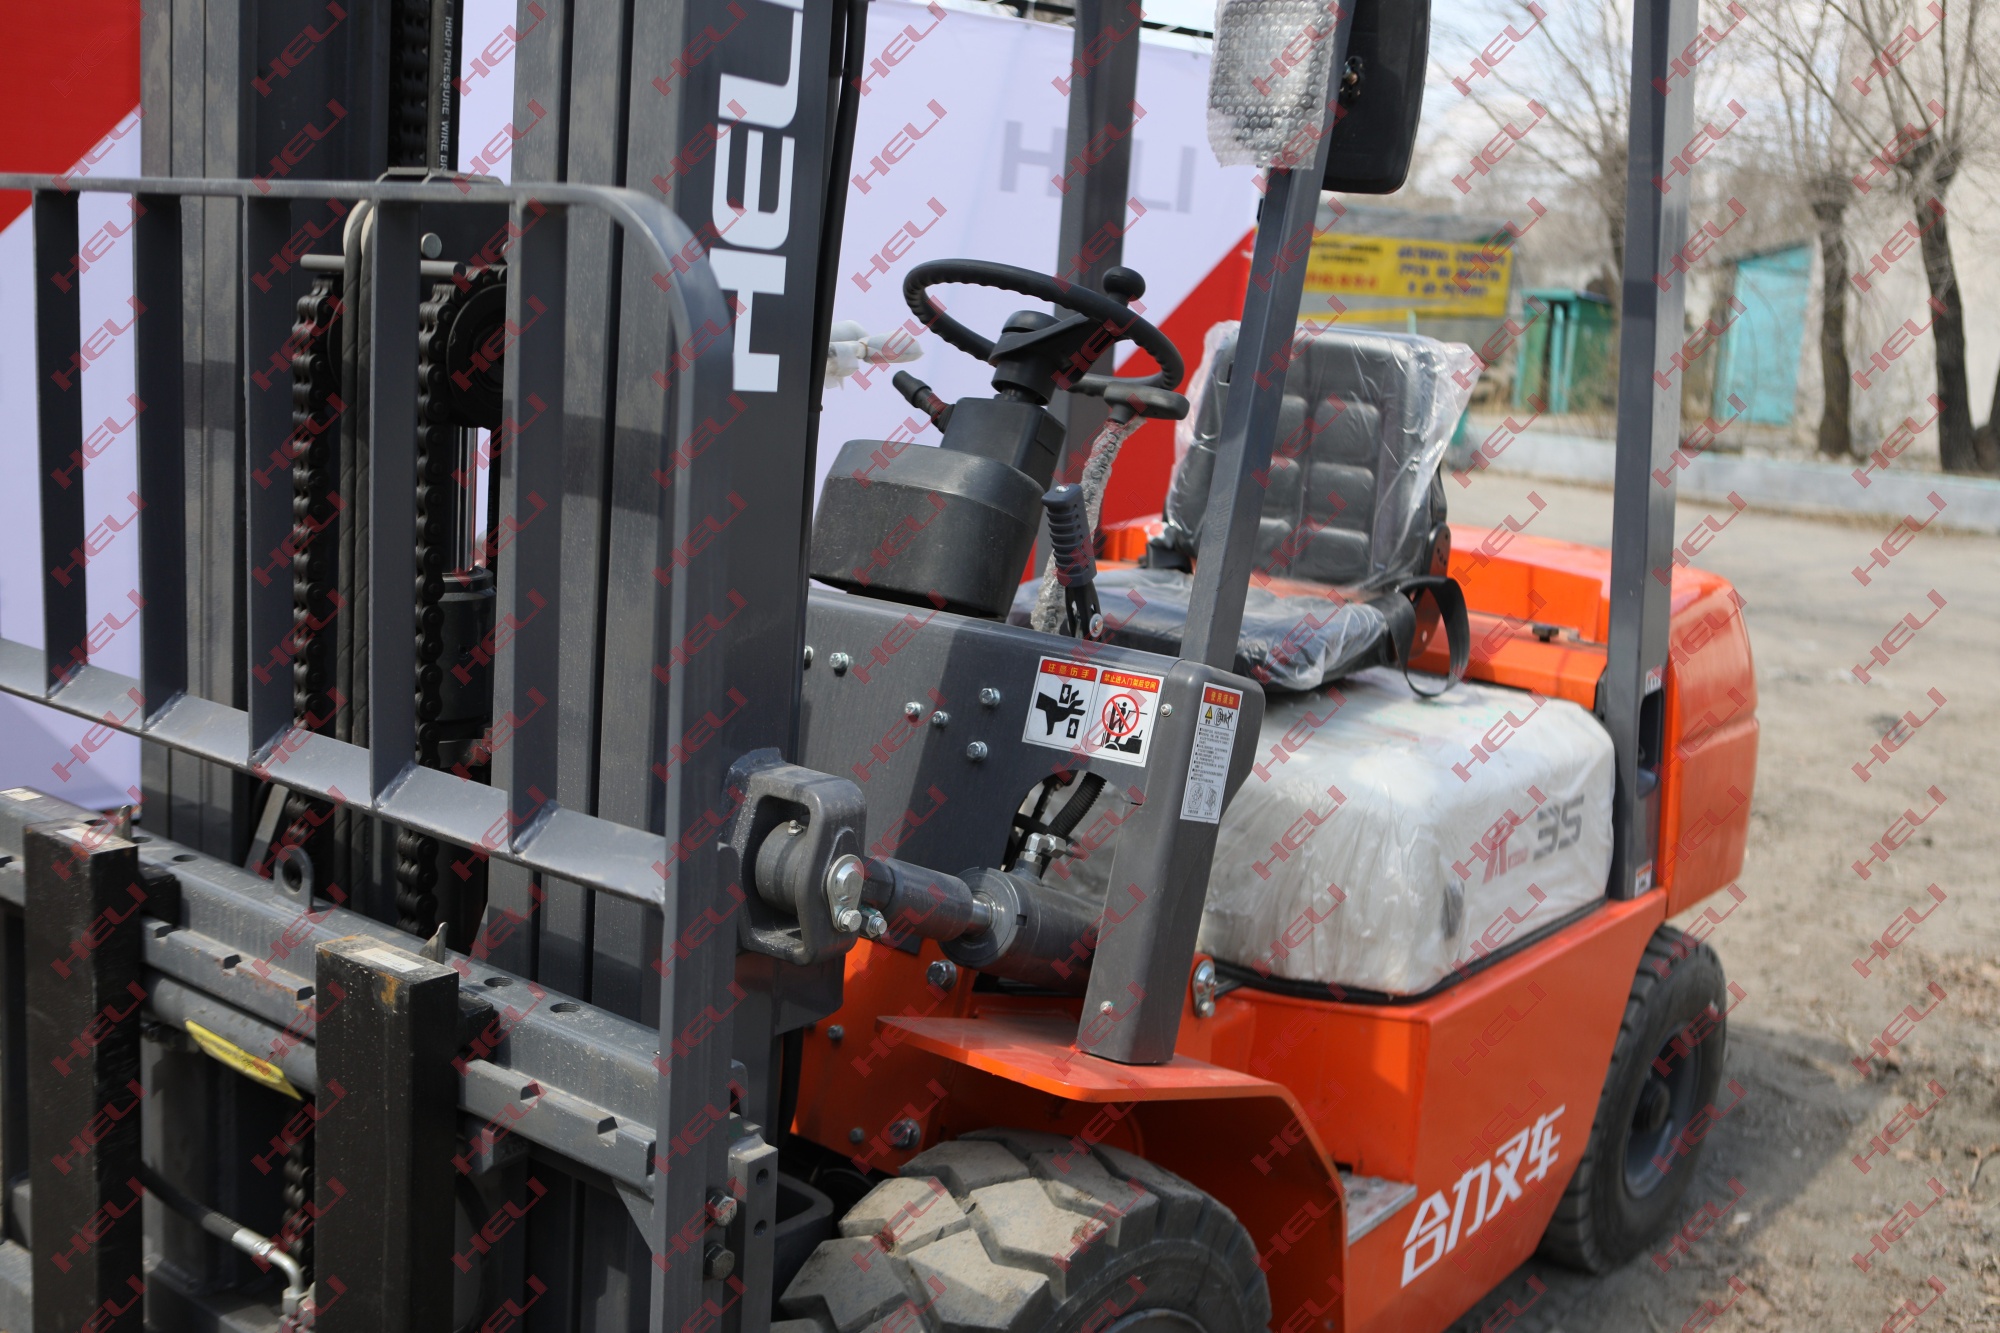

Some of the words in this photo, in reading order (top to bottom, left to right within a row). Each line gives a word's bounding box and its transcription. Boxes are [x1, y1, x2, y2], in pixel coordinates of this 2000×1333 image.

[445, 16, 453, 47] HIGH
[441, 49, 452, 115] PRESSURE
[440, 120, 449, 151] WIRE
[1000, 119, 1197, 214] HLI
[709, 0, 805, 392] HEL
[1048, 663, 1090, 679] 注意伤手
[1104, 673, 1157, 690] 禁止进入门架后空间
[1533, 794, 1585, 862] 35
[1400, 1103, 1567, 1290] 合力叉车
